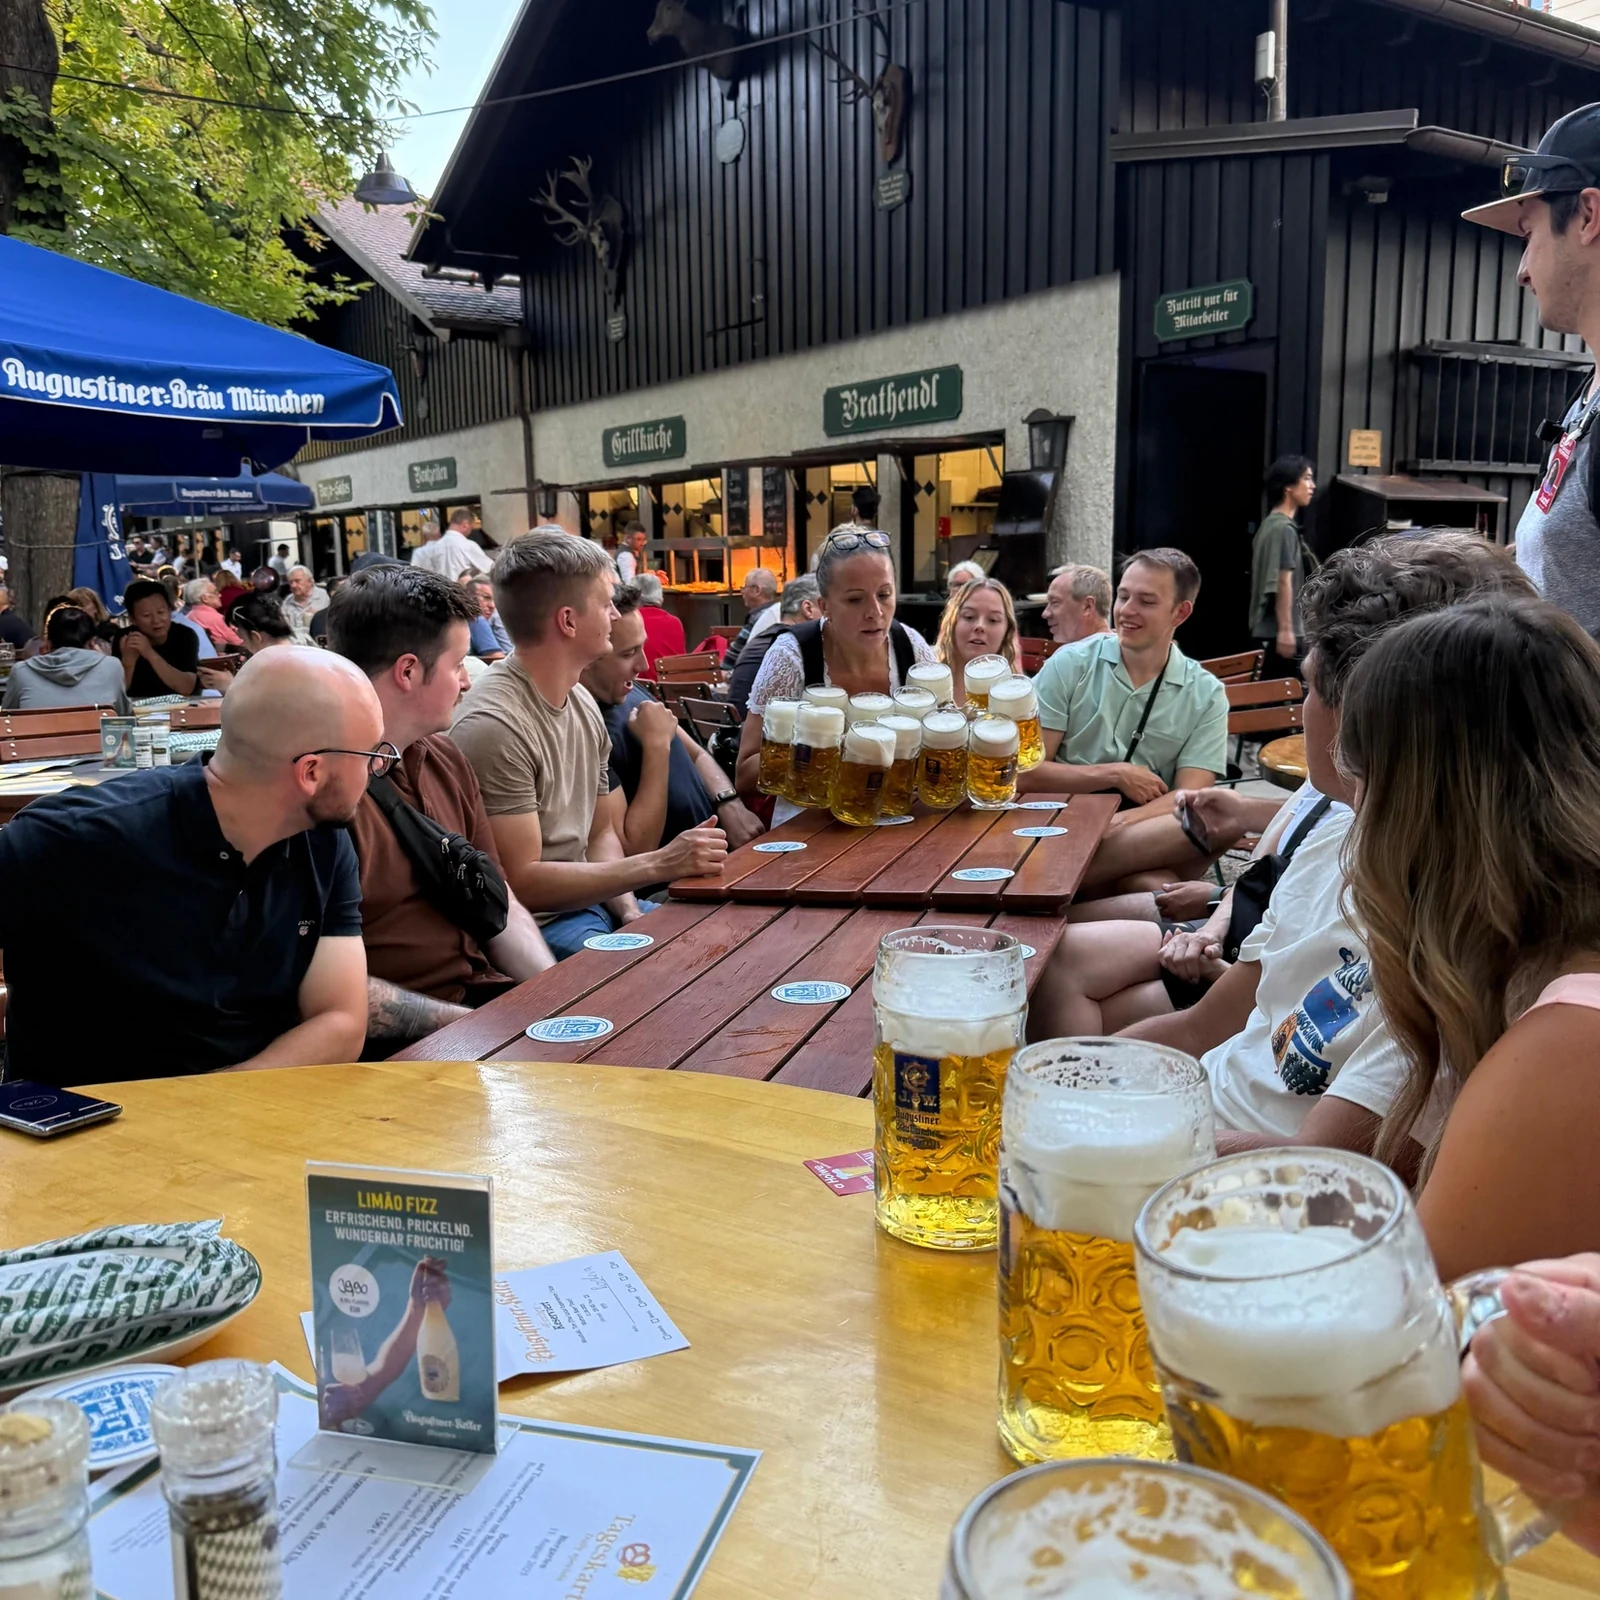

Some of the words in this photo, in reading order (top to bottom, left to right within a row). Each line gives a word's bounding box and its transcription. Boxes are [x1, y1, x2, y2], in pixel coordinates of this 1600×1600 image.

[1166, 295, 1202, 316] Zutritt
[1223, 289, 1239, 303] für
[1173, 309, 1229, 331] Mitarbeiter
[227, 386, 325, 414] München
[840, 373, 940, 428] Brathendl
[611, 422, 673, 461] Grillküche
[895, 1106, 940, 1126] Augustiner
[357, 1190, 402, 1213] LIMÃO
[406, 1196, 438, 1216] FIZZ
[325, 1210, 405, 1232] ERFRISCHEND.
[407, 1219, 474, 1239] PRICKELND.
[335, 1226, 404, 1248] WUNDERBAR
[406, 1234, 465, 1253] FRUCHTIG!
[539, 1301, 565, 1329] Reserviert
[538, 1534, 568, 1568] Biergarten
